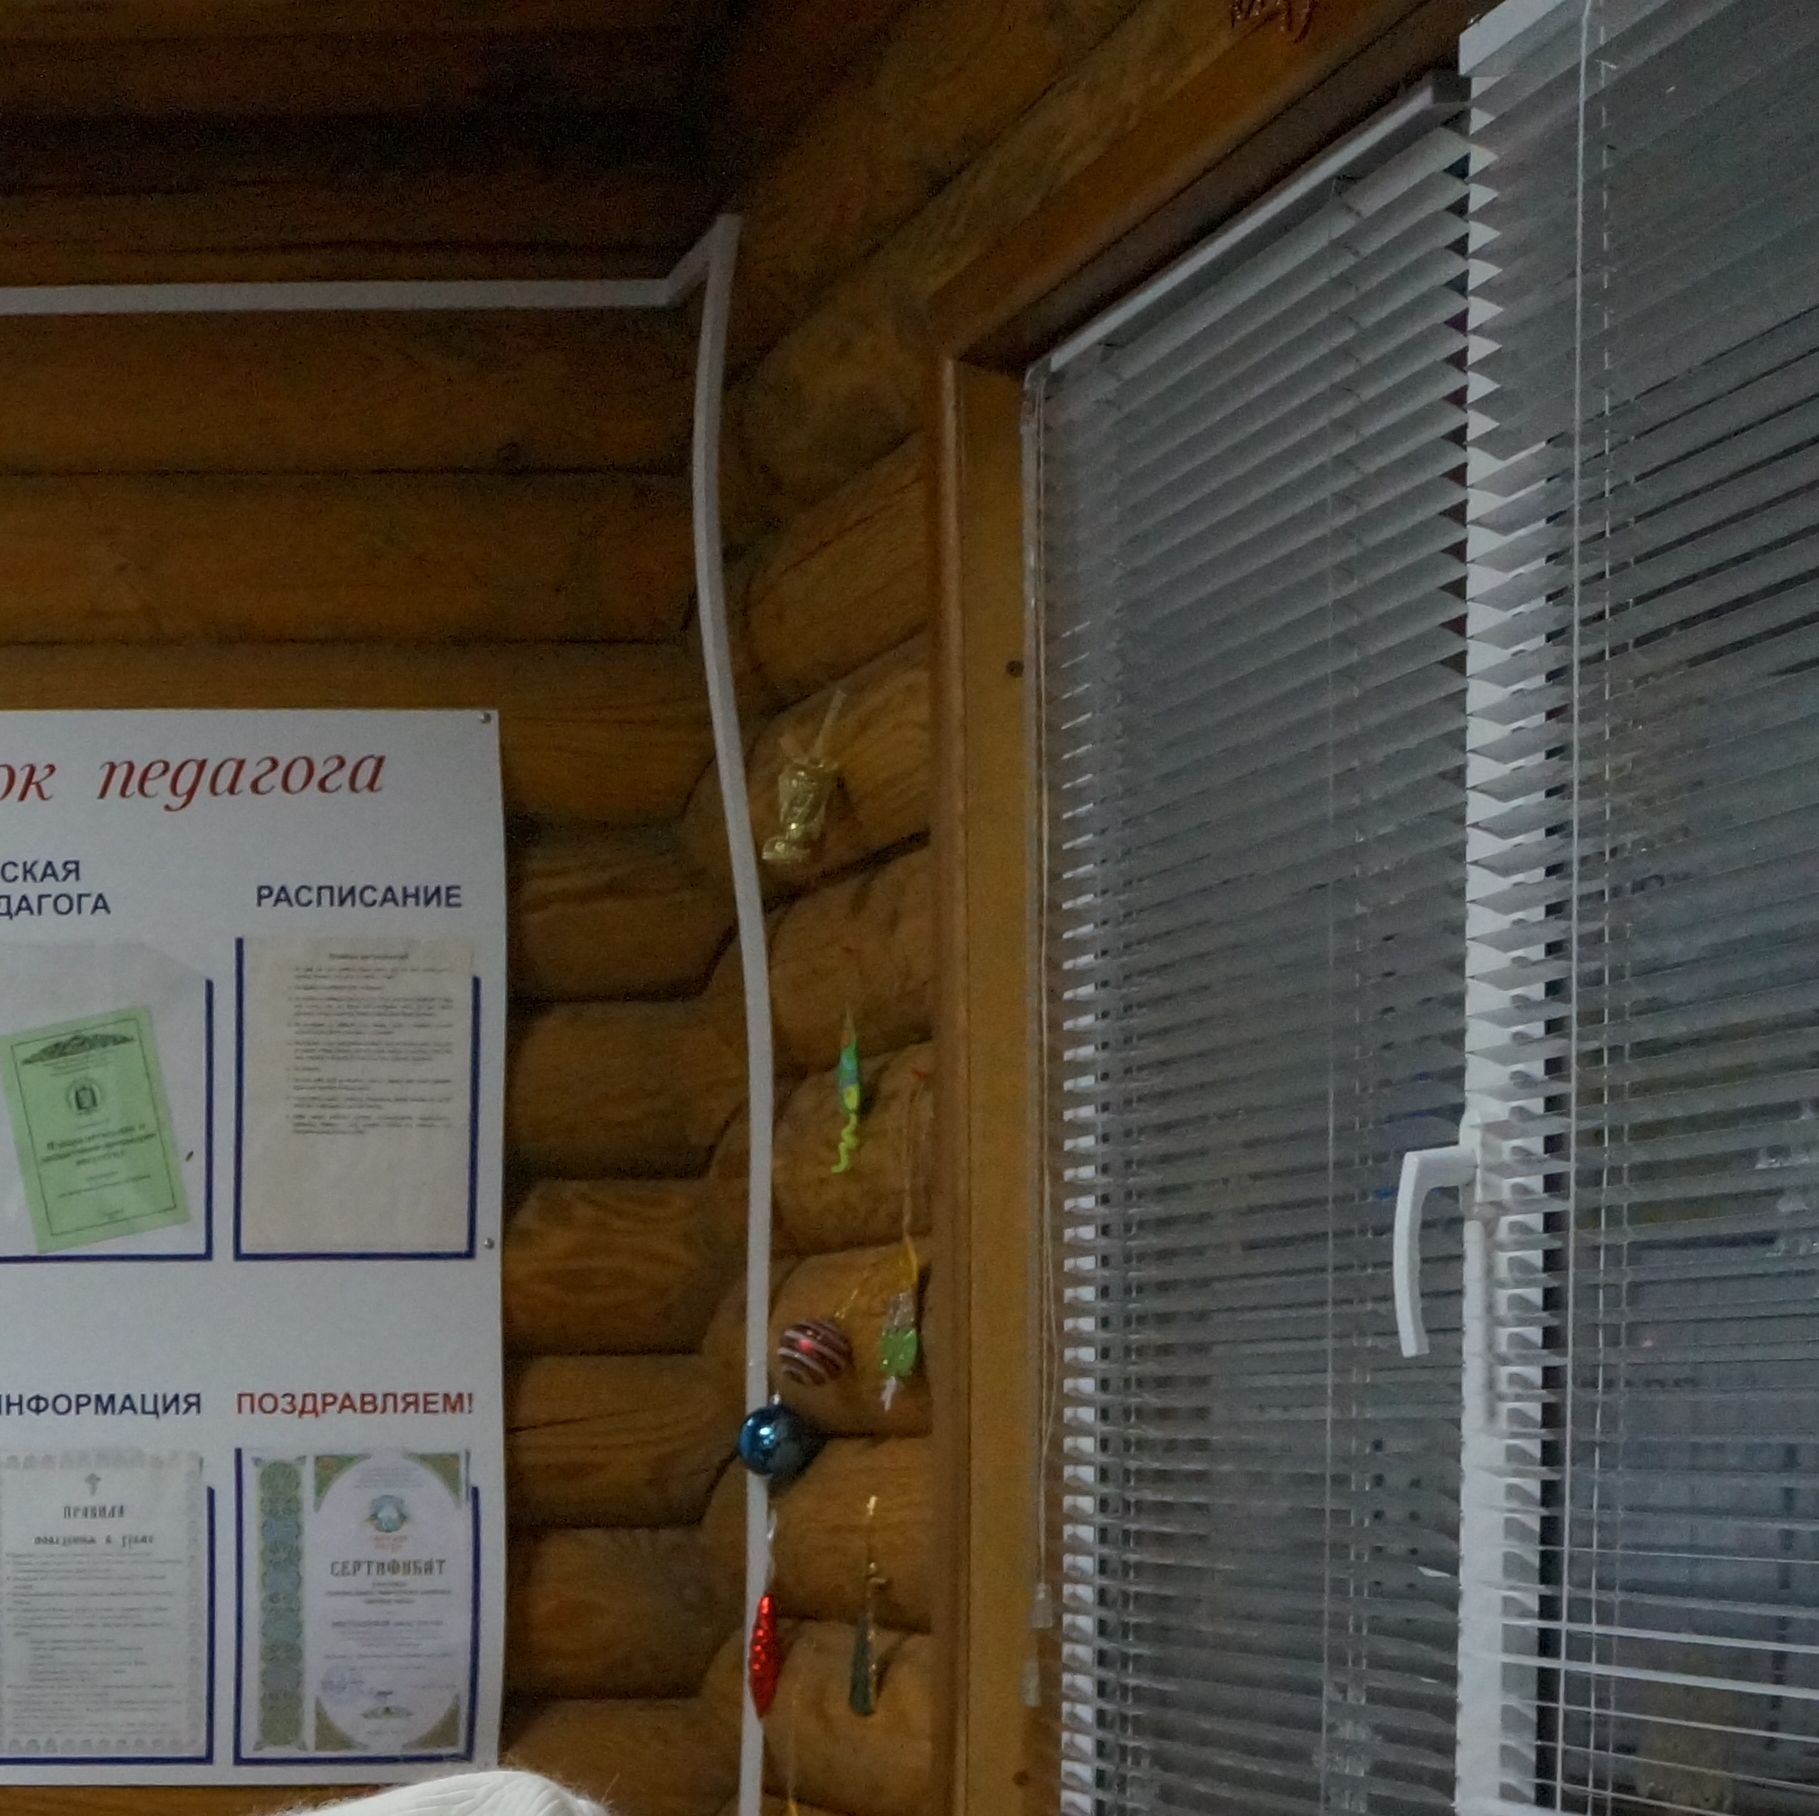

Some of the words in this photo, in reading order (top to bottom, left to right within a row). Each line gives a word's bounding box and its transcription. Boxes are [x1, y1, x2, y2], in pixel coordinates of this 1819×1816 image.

[98, 754, 386, 812] педагога
[257, 884, 462, 908] РАСПИСАНИЕ
[237, 1392, 473, 1418] ПОЗДРАВЛЯЕМ!
